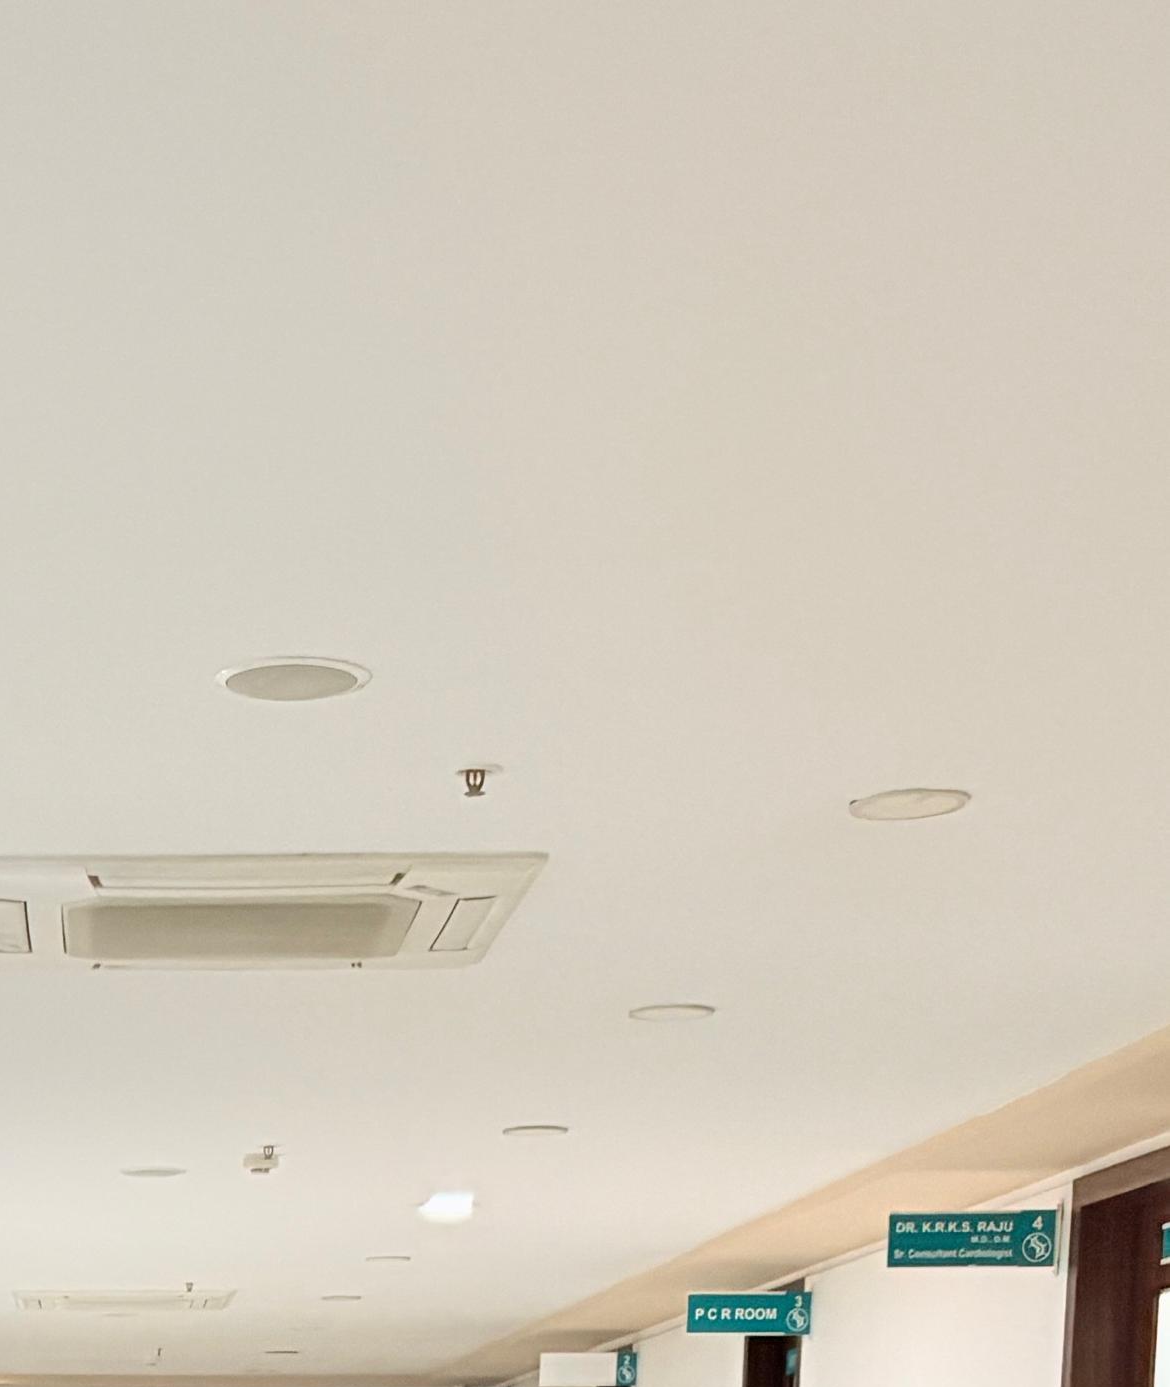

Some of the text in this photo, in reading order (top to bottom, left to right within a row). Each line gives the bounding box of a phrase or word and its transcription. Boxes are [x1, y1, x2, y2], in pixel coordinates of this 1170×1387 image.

[895, 1221, 918, 1233] DR.
[977, 1221, 1013, 1232] RAJU
[1032, 1215, 1043, 1230] 4
[794, 1295, 803, 1308] 3
[695, 1308, 778, 1320] P C R ROOM
[623, 1355, 630, 1364] 2
